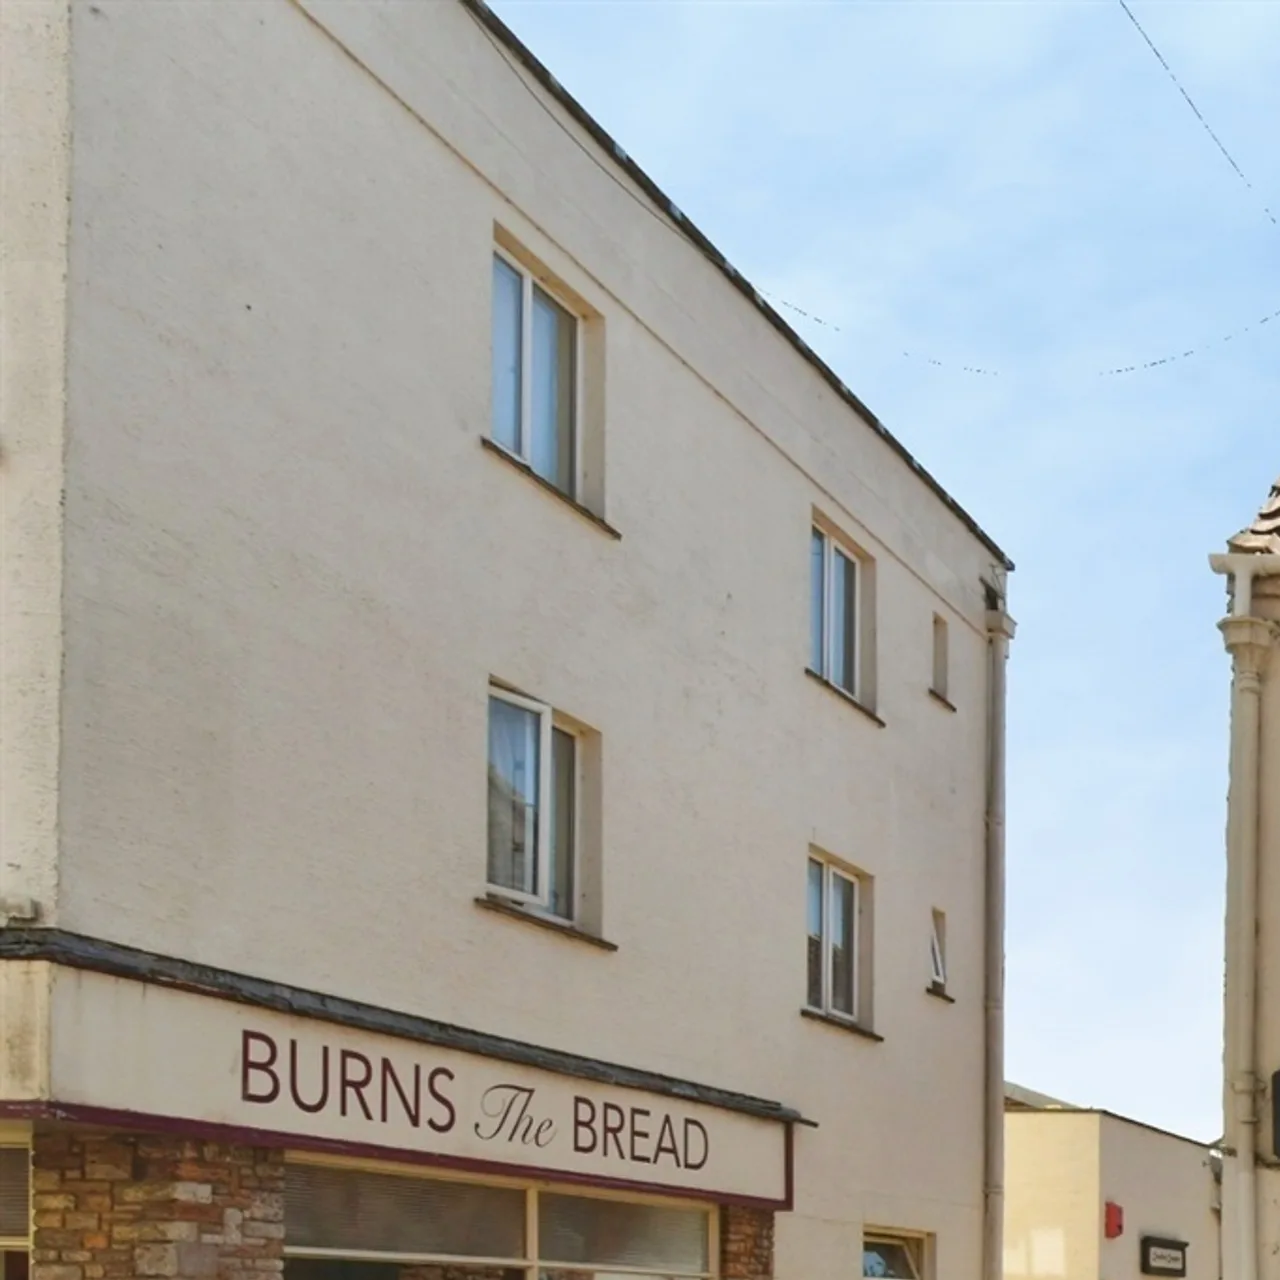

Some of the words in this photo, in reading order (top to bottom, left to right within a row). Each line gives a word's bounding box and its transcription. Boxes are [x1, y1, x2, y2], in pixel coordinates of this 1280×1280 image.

[241, 1029, 456, 1133] BURNS
[474, 1083, 557, 1149] The
[573, 1095, 709, 1171] BREAD
